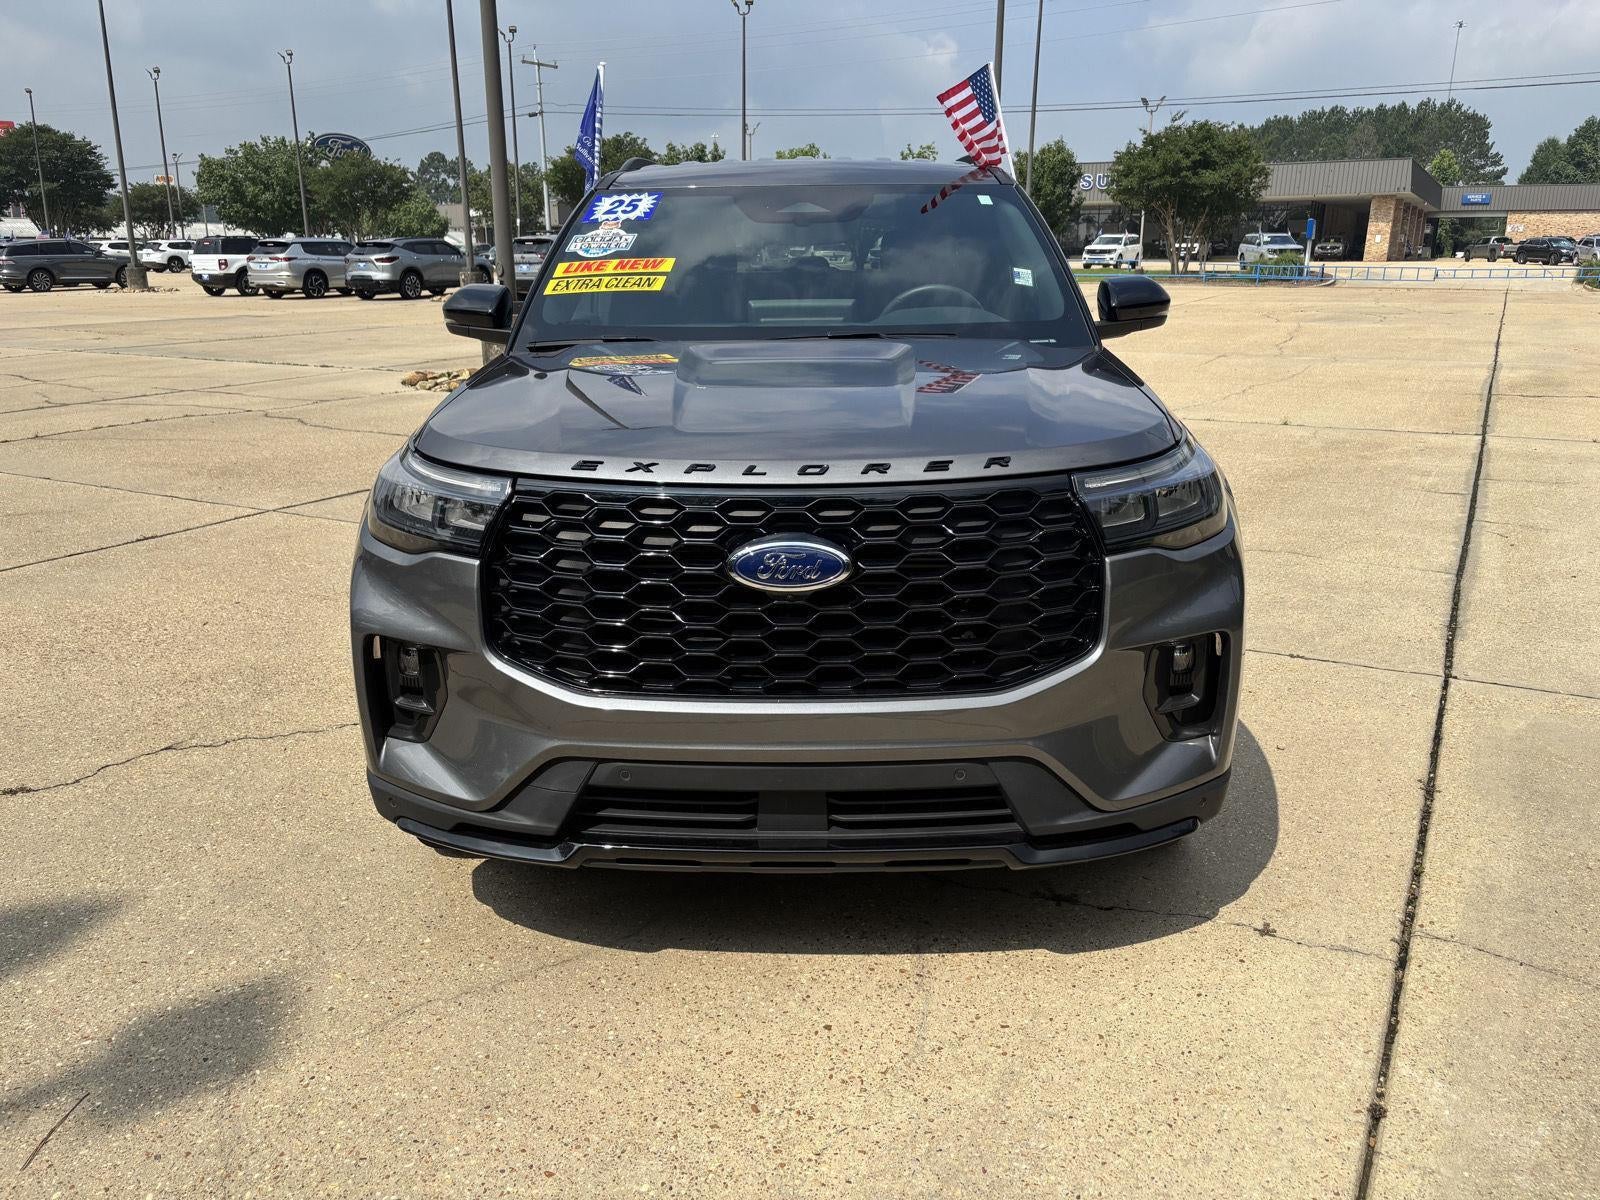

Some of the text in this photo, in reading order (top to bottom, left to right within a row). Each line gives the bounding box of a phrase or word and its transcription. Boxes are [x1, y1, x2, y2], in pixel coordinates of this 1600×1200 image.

[601, 199, 643, 215] 25
[563, 258, 666, 274] LIKE NEW
[552, 276, 656, 292] EXTRA CLEAN
[571, 455, 1011, 477] EXPLORER
[757, 551, 822, 580] Ford
